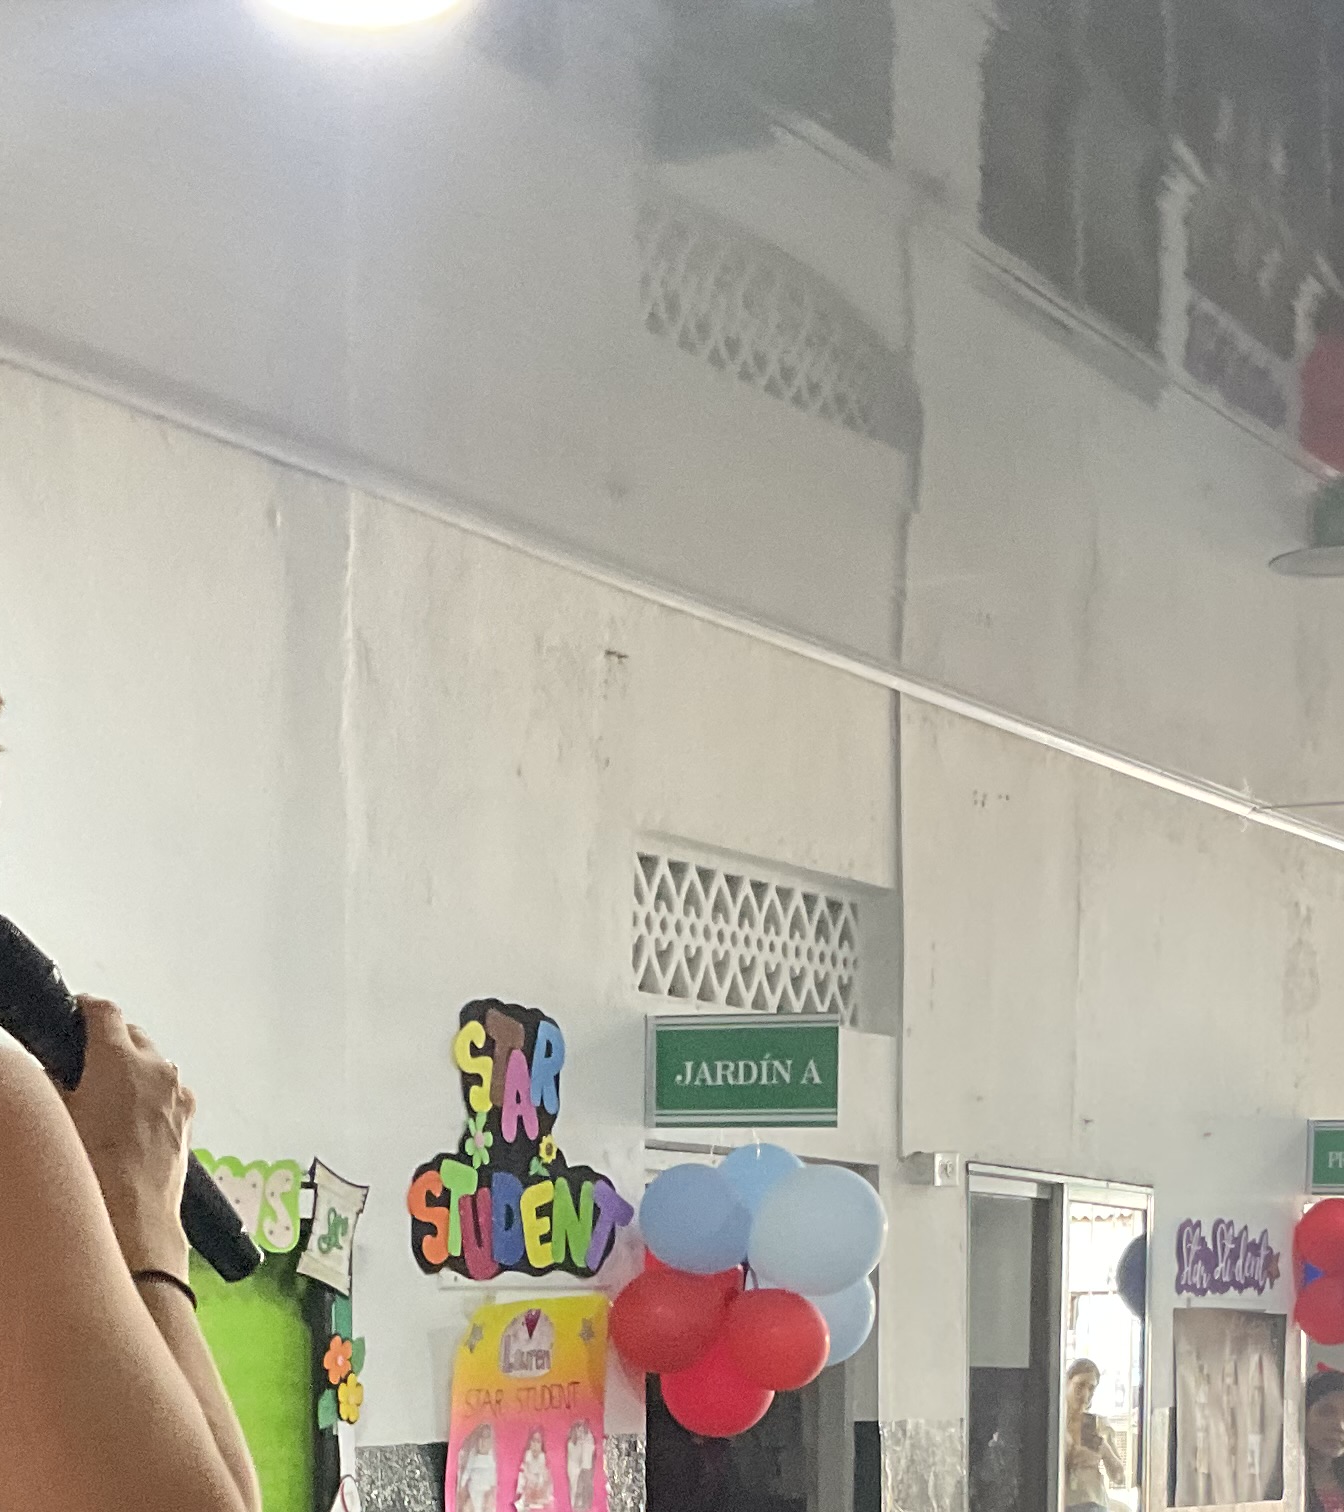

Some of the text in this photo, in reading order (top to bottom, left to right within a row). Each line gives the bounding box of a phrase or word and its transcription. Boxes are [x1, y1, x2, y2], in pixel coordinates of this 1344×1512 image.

[453, 1008, 566, 1143] STAR
[674, 1053, 823, 1086] JARDÍN A
[407, 1159, 635, 1281] STUDENT
[1180, 1225, 1212, 1289] Star
[464, 1380, 581, 1418] STAR STUDENT
